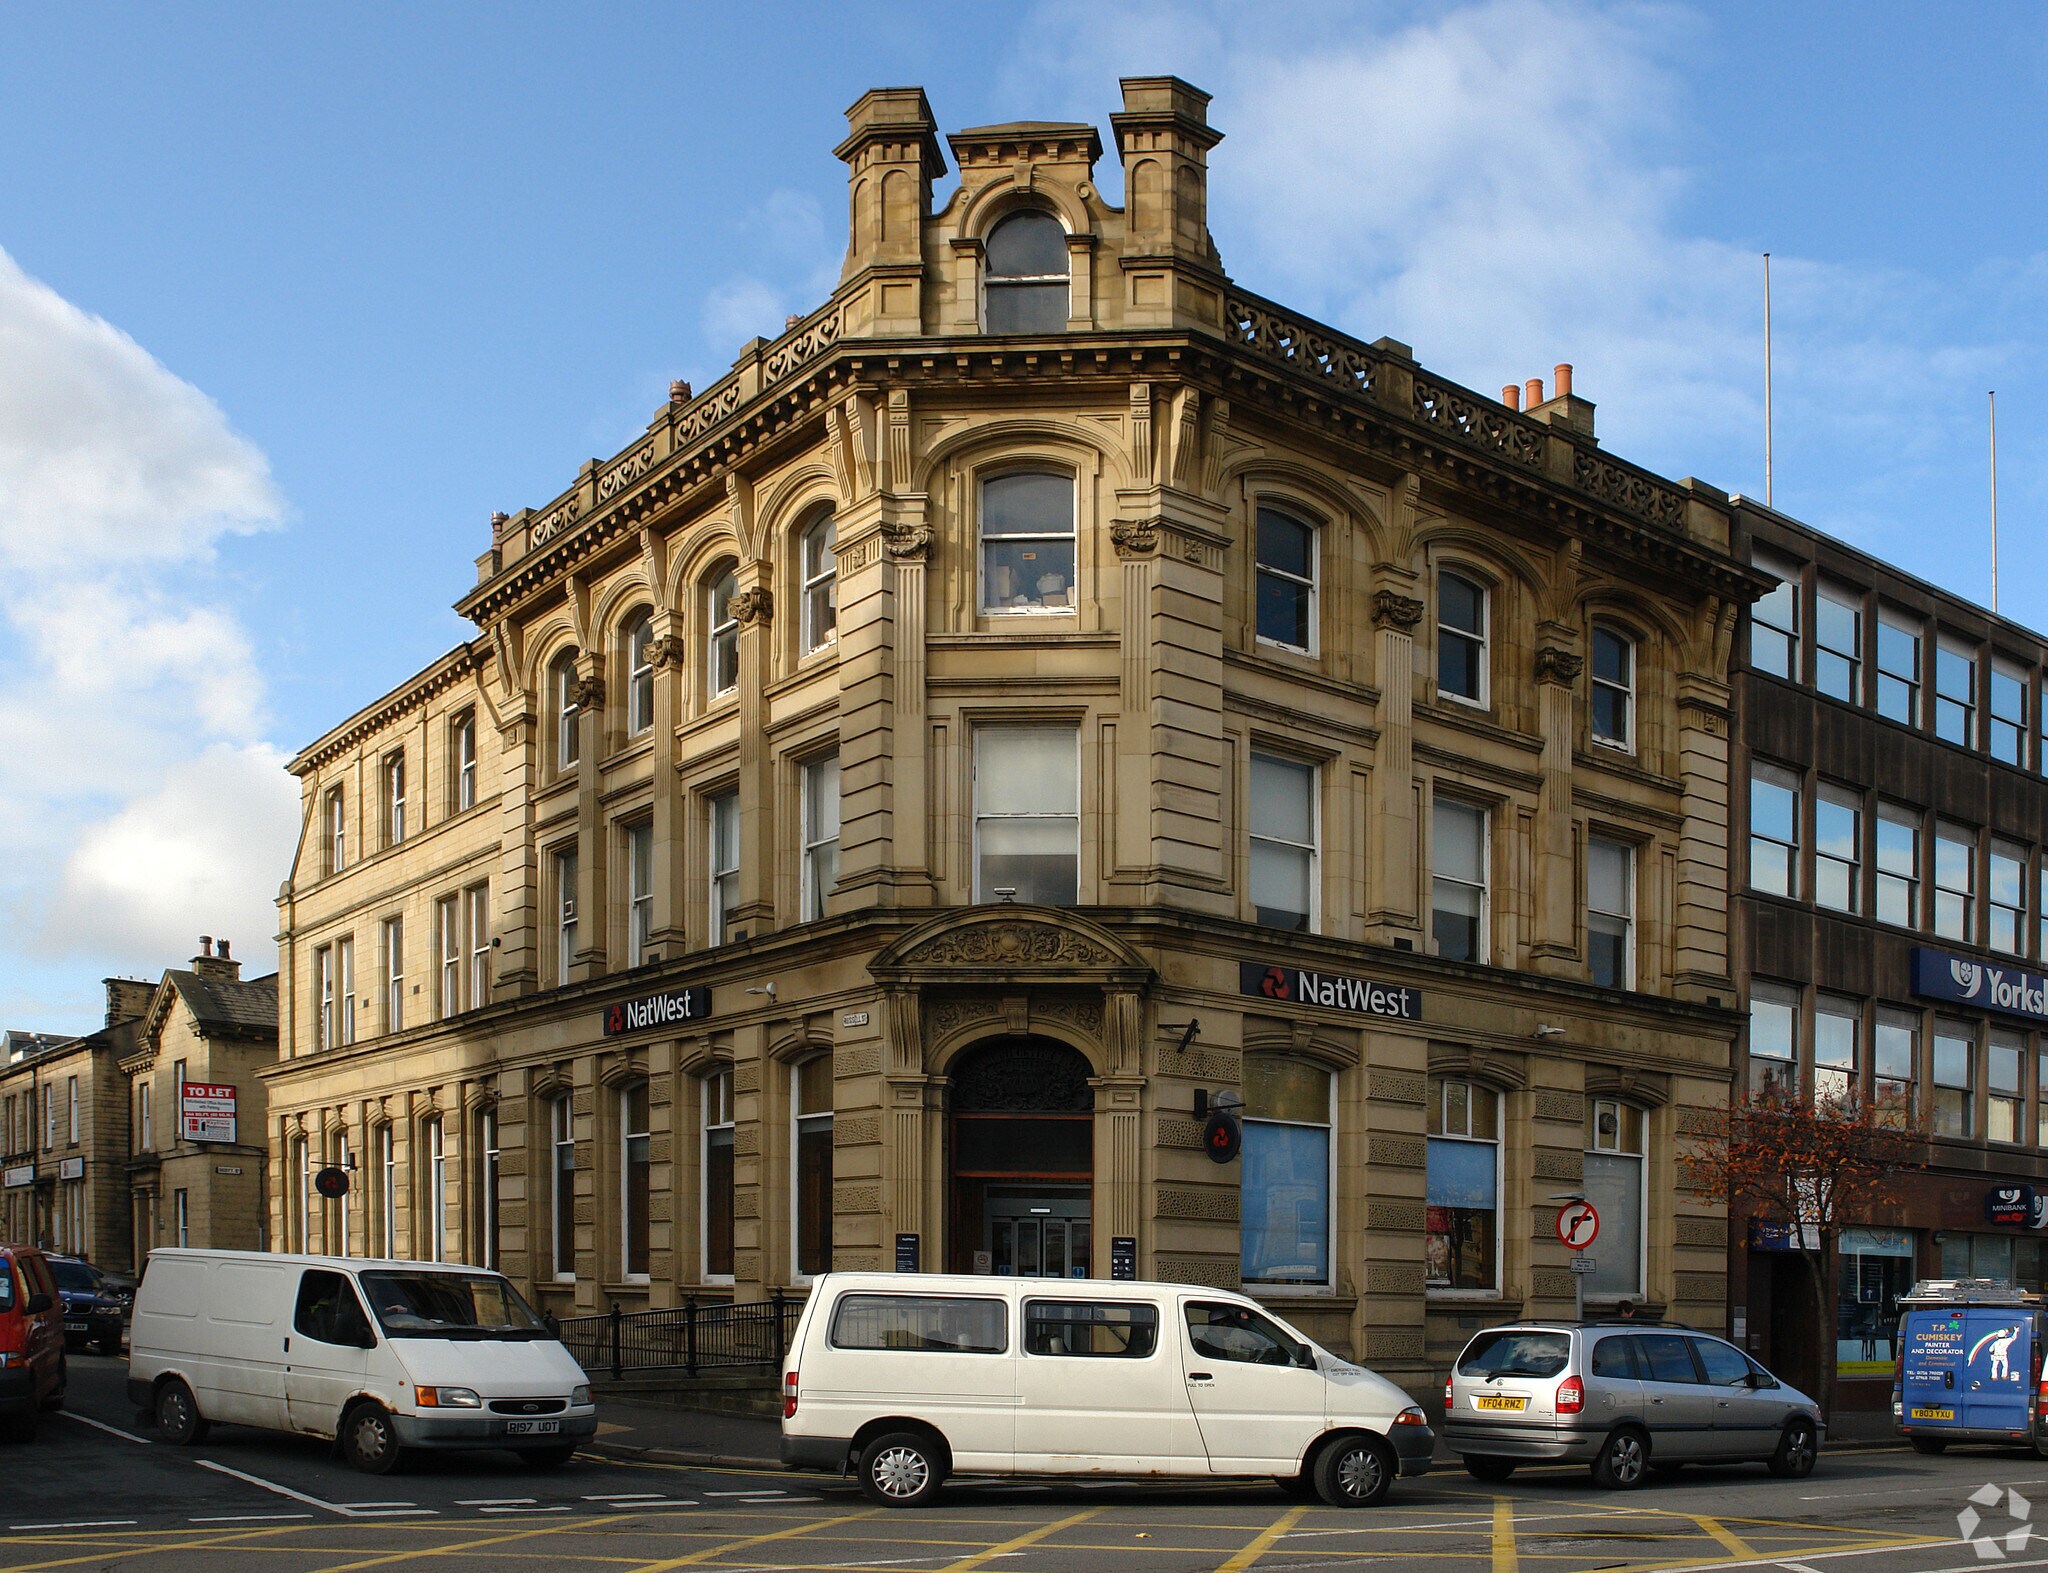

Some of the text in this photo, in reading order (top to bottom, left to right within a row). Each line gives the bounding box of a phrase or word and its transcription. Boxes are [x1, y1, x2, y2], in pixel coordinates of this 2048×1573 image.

[1299, 971, 1410, 1018] NatWest
[627, 989, 692, 1029] NatWest
[187, 1087, 232, 1097] TO LET
[1992, 1204, 2027, 1212] MINIBANK
[1932, 1324, 1948, 1332] T.P.
[1916, 1333, 1963, 1342] CUMISKEY
[1483, 1398, 1521, 1409] YF04 RMZ
[1935, 1410, 1951, 1419] YXU
[538, 1421, 558, 1432] UDT
